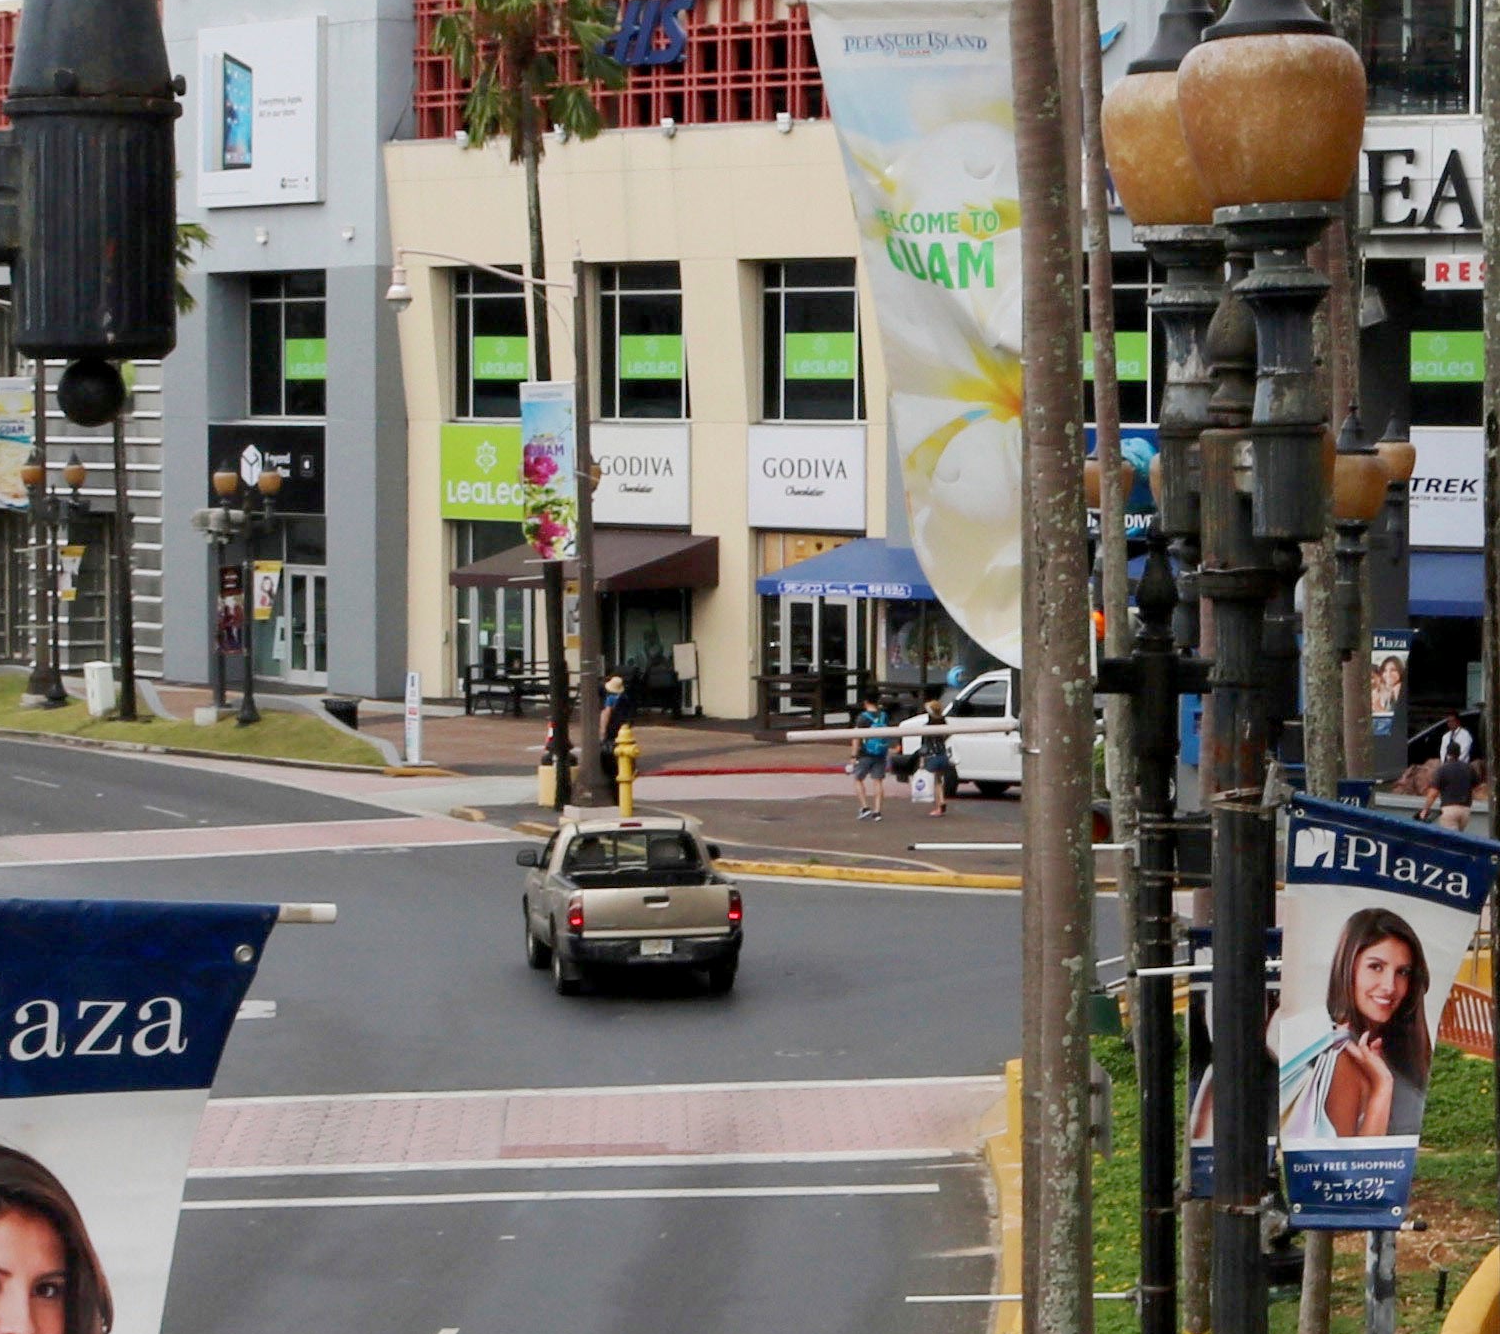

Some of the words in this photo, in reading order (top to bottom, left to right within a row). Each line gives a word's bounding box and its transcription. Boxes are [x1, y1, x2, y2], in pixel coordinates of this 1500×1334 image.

[843, 31, 923, 54] PLEASURE
[927, 30, 988, 52] ISLAND
[969, 211, 999, 233] TO
[1411, 356, 1476, 376] eaLea
[599, 455, 674, 478] GODIVA
[762, 456, 848, 480] GODIVA
[1410, 477, 1479, 494] TREK
[1372, 635, 1408, 649] Plaza
[1340, 833, 1471, 900] Plaza
[1293, 1162, 1320, 1173] DUTY
[1323, 1161, 1348, 1172] FREE
[1350, 1159, 1406, 1171] SHOPPING
[1324, 1188, 1385, 1202] ショッピング
